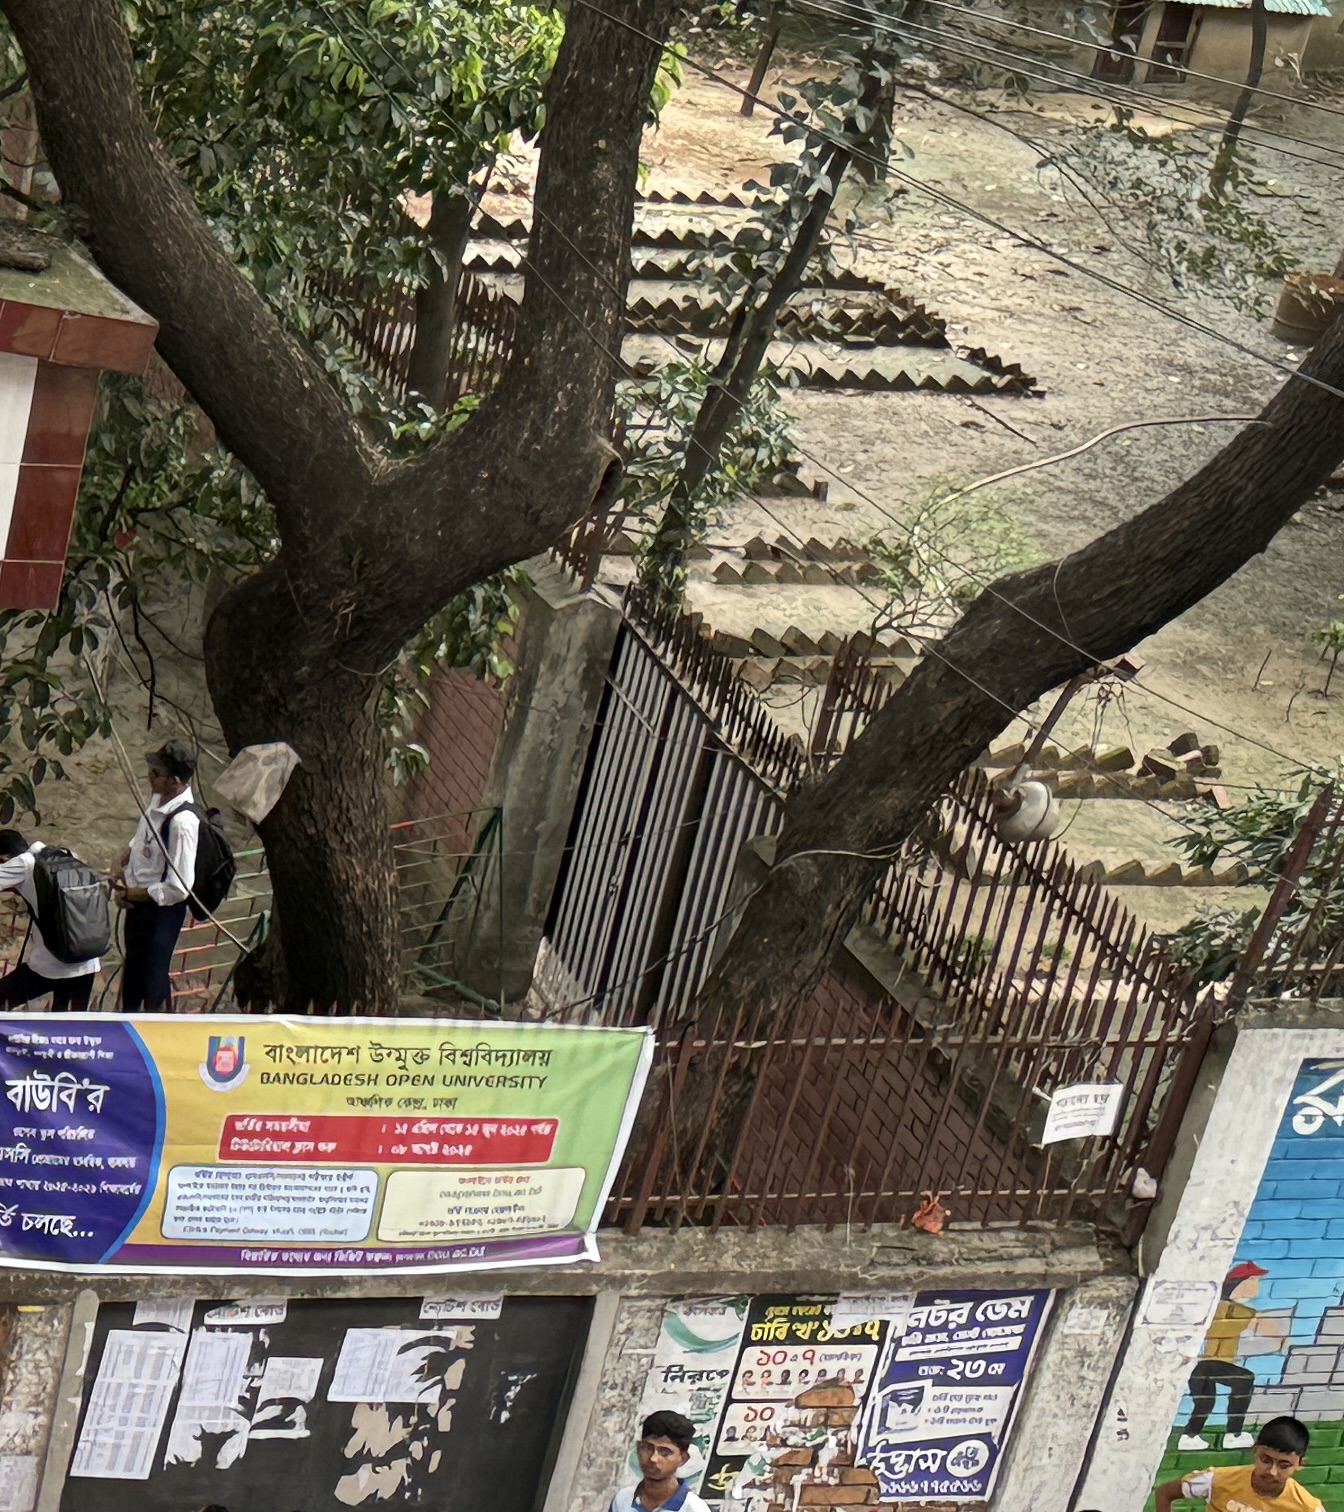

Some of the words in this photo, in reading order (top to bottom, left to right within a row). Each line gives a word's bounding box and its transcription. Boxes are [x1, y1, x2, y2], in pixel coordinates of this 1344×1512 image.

[264, 1043, 361, 1066] বাংলাদেশ
[369, 1041, 430, 1071] উন্মুক্ত
[439, 1042, 554, 1069] বিশ্ববিদ্যালয়
[260, 1072, 380, 1087] BANGLADESH
[386, 1073, 436, 1088] OPEN
[443, 1075, 549, 1090] UNIVERSITY
[907, 1298, 975, 1329] নটর
[976, 1295, 1035, 1322] ডেম
[756, 1349, 789, 1367] ১০
[947, 1358, 987, 1381] ২৩
[743, 1405, 775, 1422] ১০
